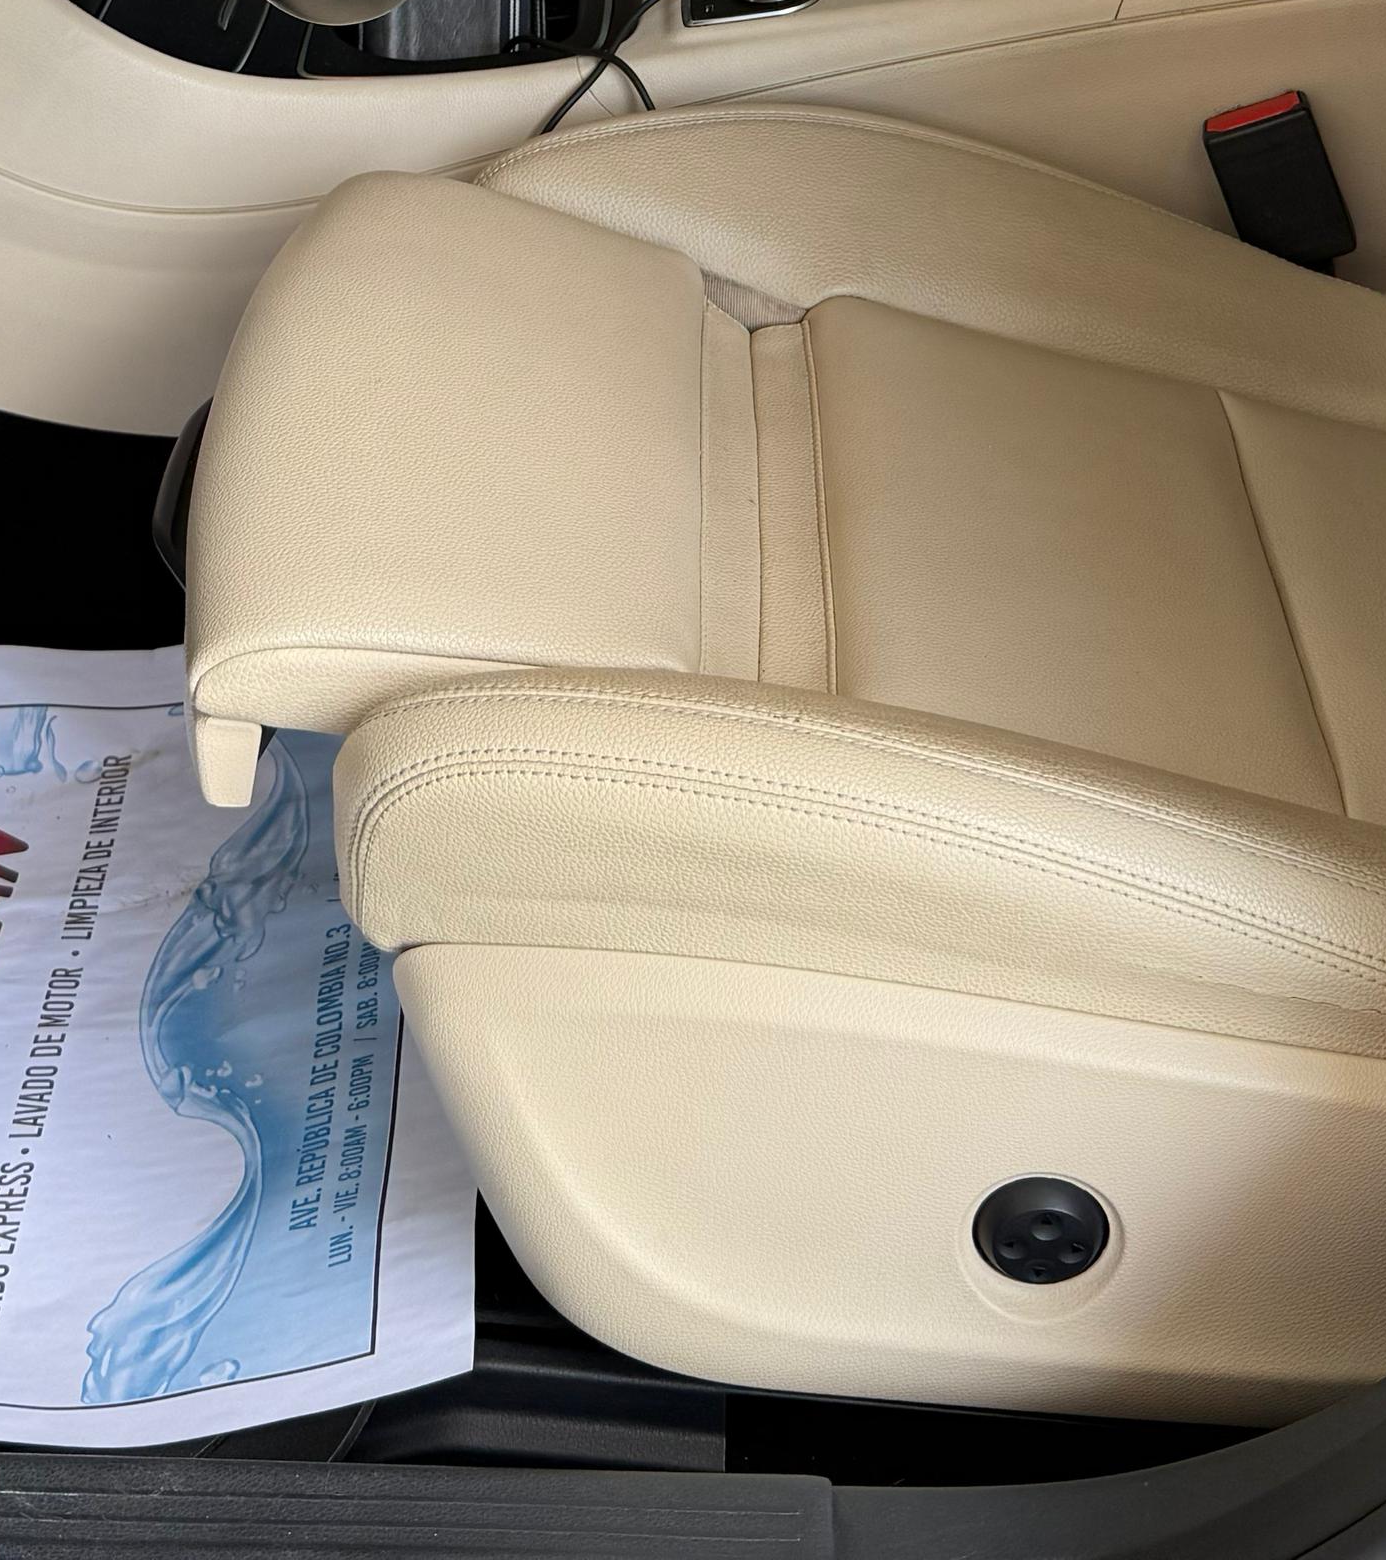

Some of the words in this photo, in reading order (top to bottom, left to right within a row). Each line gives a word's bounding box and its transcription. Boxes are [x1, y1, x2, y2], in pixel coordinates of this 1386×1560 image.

[89, 754, 133, 835] INTERIOR
[83, 838, 115, 861] DE
[61, 863, 109, 940] LIMPIEZA
[323, 923, 352, 967] NO.3
[37, 967, 84, 1028] MOTOR
[314, 964, 347, 1059] COLOMBIA
[357, 991, 380, 1030] SAB.
[30, 1032, 67, 1058] DE
[310, 1059, 339, 1086] DE
[348, 1054, 375, 1112] 6:00PM
[8, 1065, 59, 1139] LAVADO
[296, 1086, 337, 1187] REPÚBLICA
[338, 1124, 368, 1182] 8:00AM
[289, 1187, 322, 1231] AVE.
[333, 1182, 360, 1214] VIE.
[328, 1224, 354, 1268] LUN.
